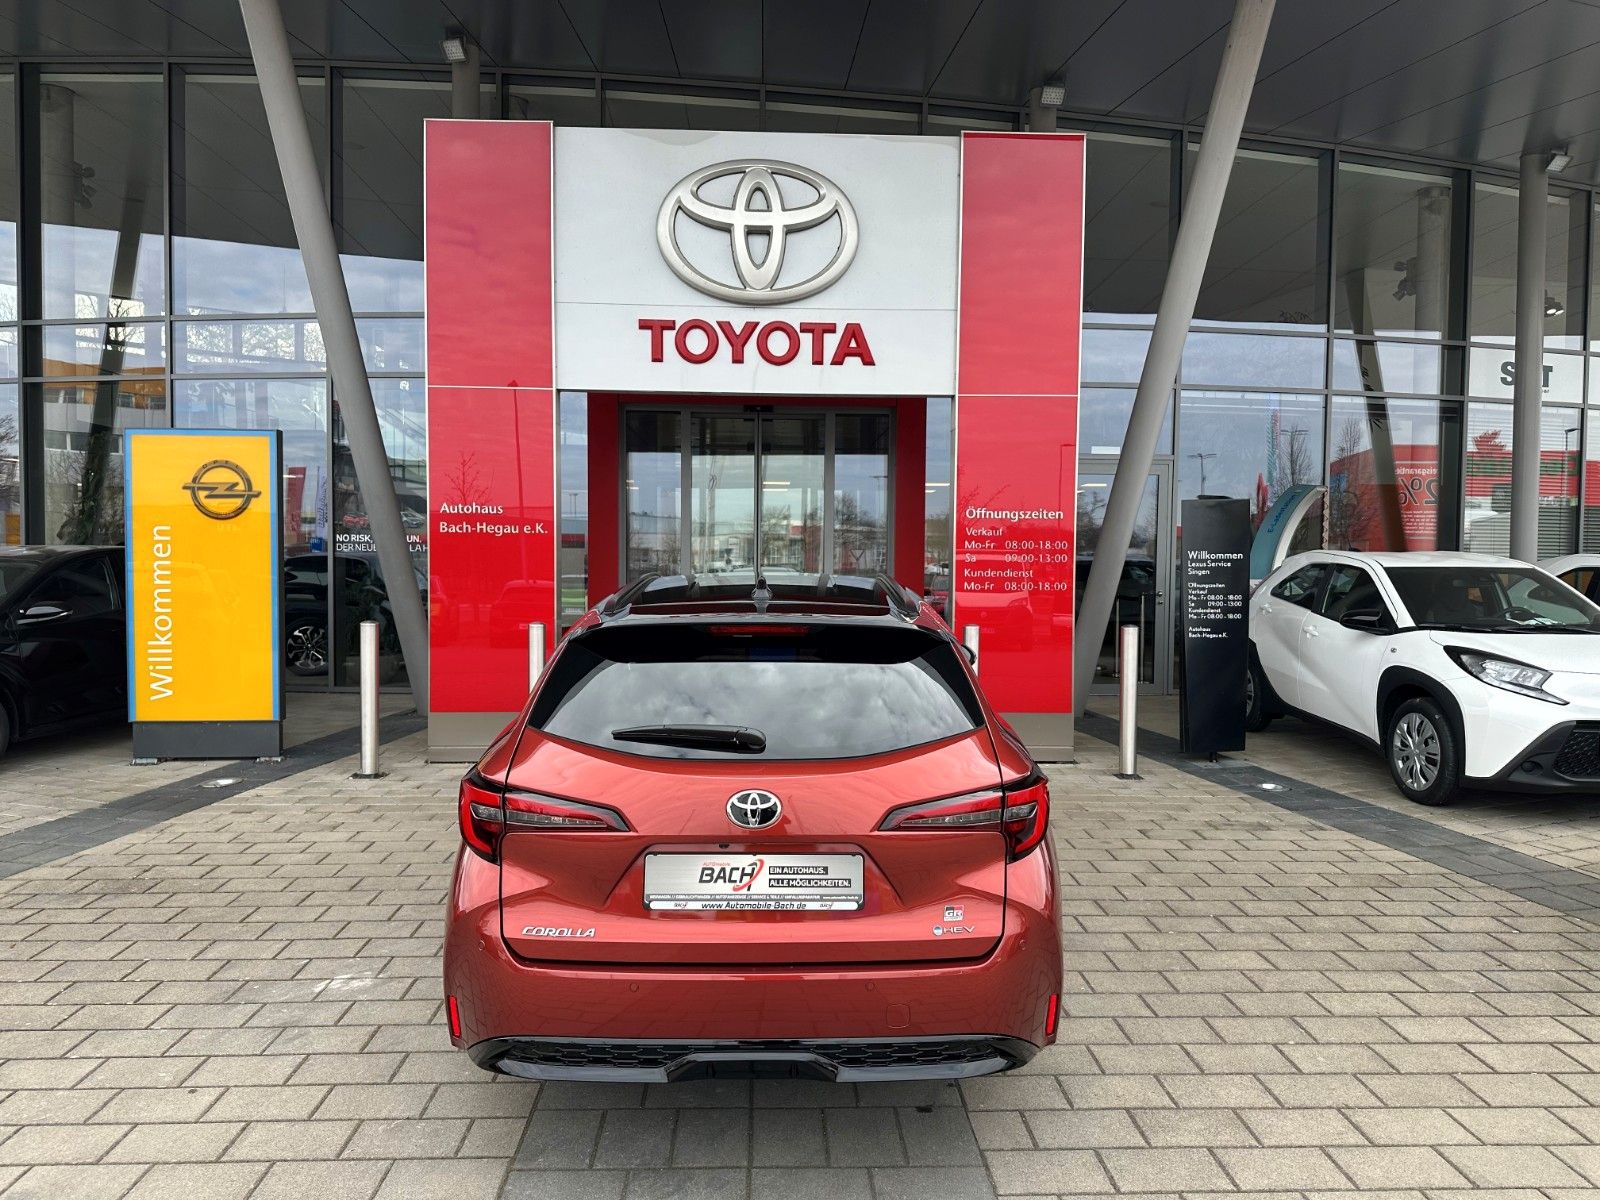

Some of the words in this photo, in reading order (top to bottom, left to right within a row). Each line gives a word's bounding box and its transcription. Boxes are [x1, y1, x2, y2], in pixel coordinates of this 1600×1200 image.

[638, 318, 876, 366] TOYOTA
[439, 502, 503, 514] Autohaus
[966, 506, 1064, 522] Öffnungszeiten
[439, 521, 519, 537] Bach-Hegau
[523, 523, 548, 534] e.K.
[966, 527, 1004, 537] Verkauf
[336, 533, 350, 542] NO
[351, 533, 374, 544] RISK,
[336, 543, 354, 552] DER
[964, 540, 995, 550] Mo-Fr
[1005, 540, 1068, 550] 08:00-18:00
[965, 553, 977, 563] Sa
[1004, 553, 1068, 563] 09:00-13:00
[1188, 551, 1244, 560] Willkommen
[964, 568, 1034, 578] Kundendienst
[964, 581, 994, 591] Mo-Fr
[1004, 581, 1067, 591] 08:00-18:00
[147, 525, 173, 701] Willkommen
[770, 867, 783, 875] EIN
[783, 867, 826, 875] AUTOHAUS.
[699, 864, 758, 891] BACH
[769, 879, 788, 887] ALLE
[789, 878, 851, 887] MÖGLICHKEITEN.
[522, 926, 596, 937] COROLLA
[943, 925, 975, 934] HEV
